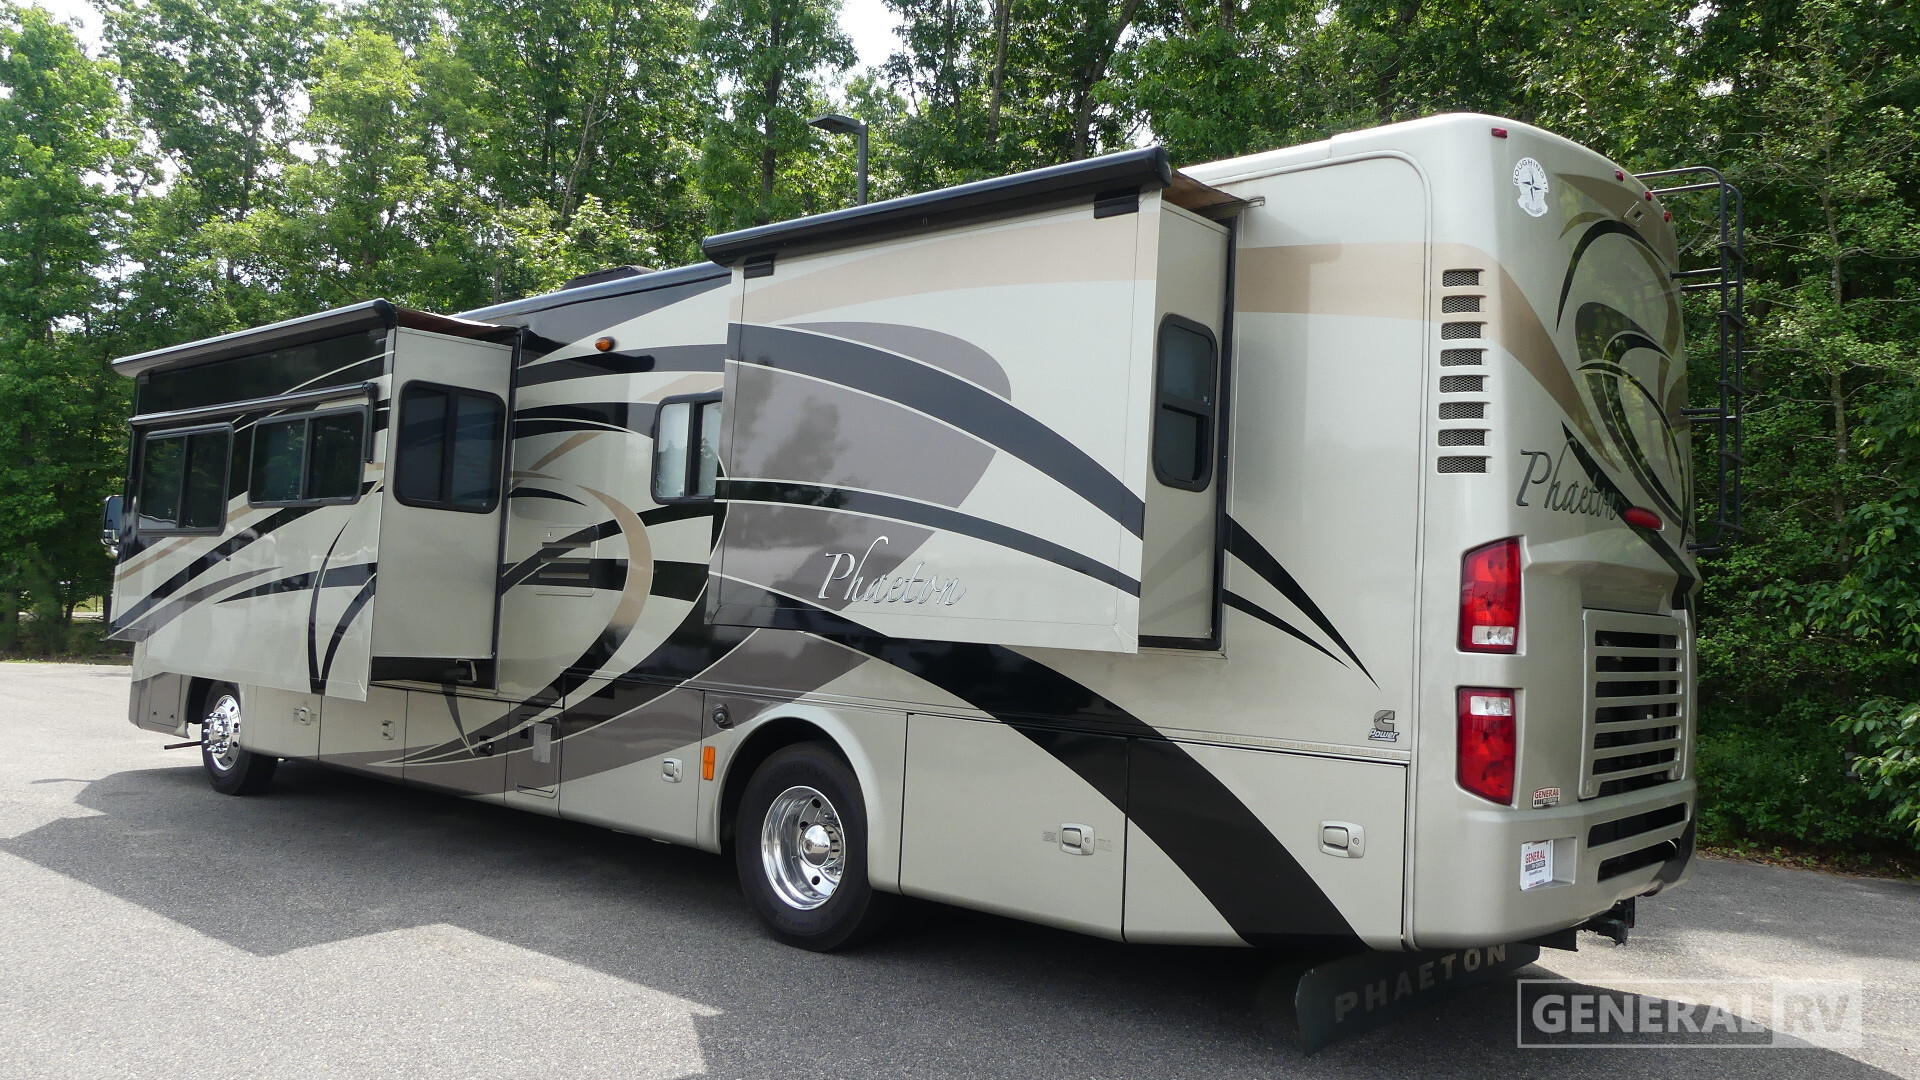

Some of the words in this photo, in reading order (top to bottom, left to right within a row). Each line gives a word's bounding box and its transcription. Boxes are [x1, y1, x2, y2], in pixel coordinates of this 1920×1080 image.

[1513, 159, 1545, 184] ROUGHING
[1516, 437, 1620, 521] Phaeton
[817, 535, 967, 606] Phaeton
[1296, 742, 1329, 752] HOMES
[1534, 788, 1559, 799] GENERAL
[1525, 850, 1546, 863] GENERAL
[1333, 943, 1507, 1025] PHAETON
